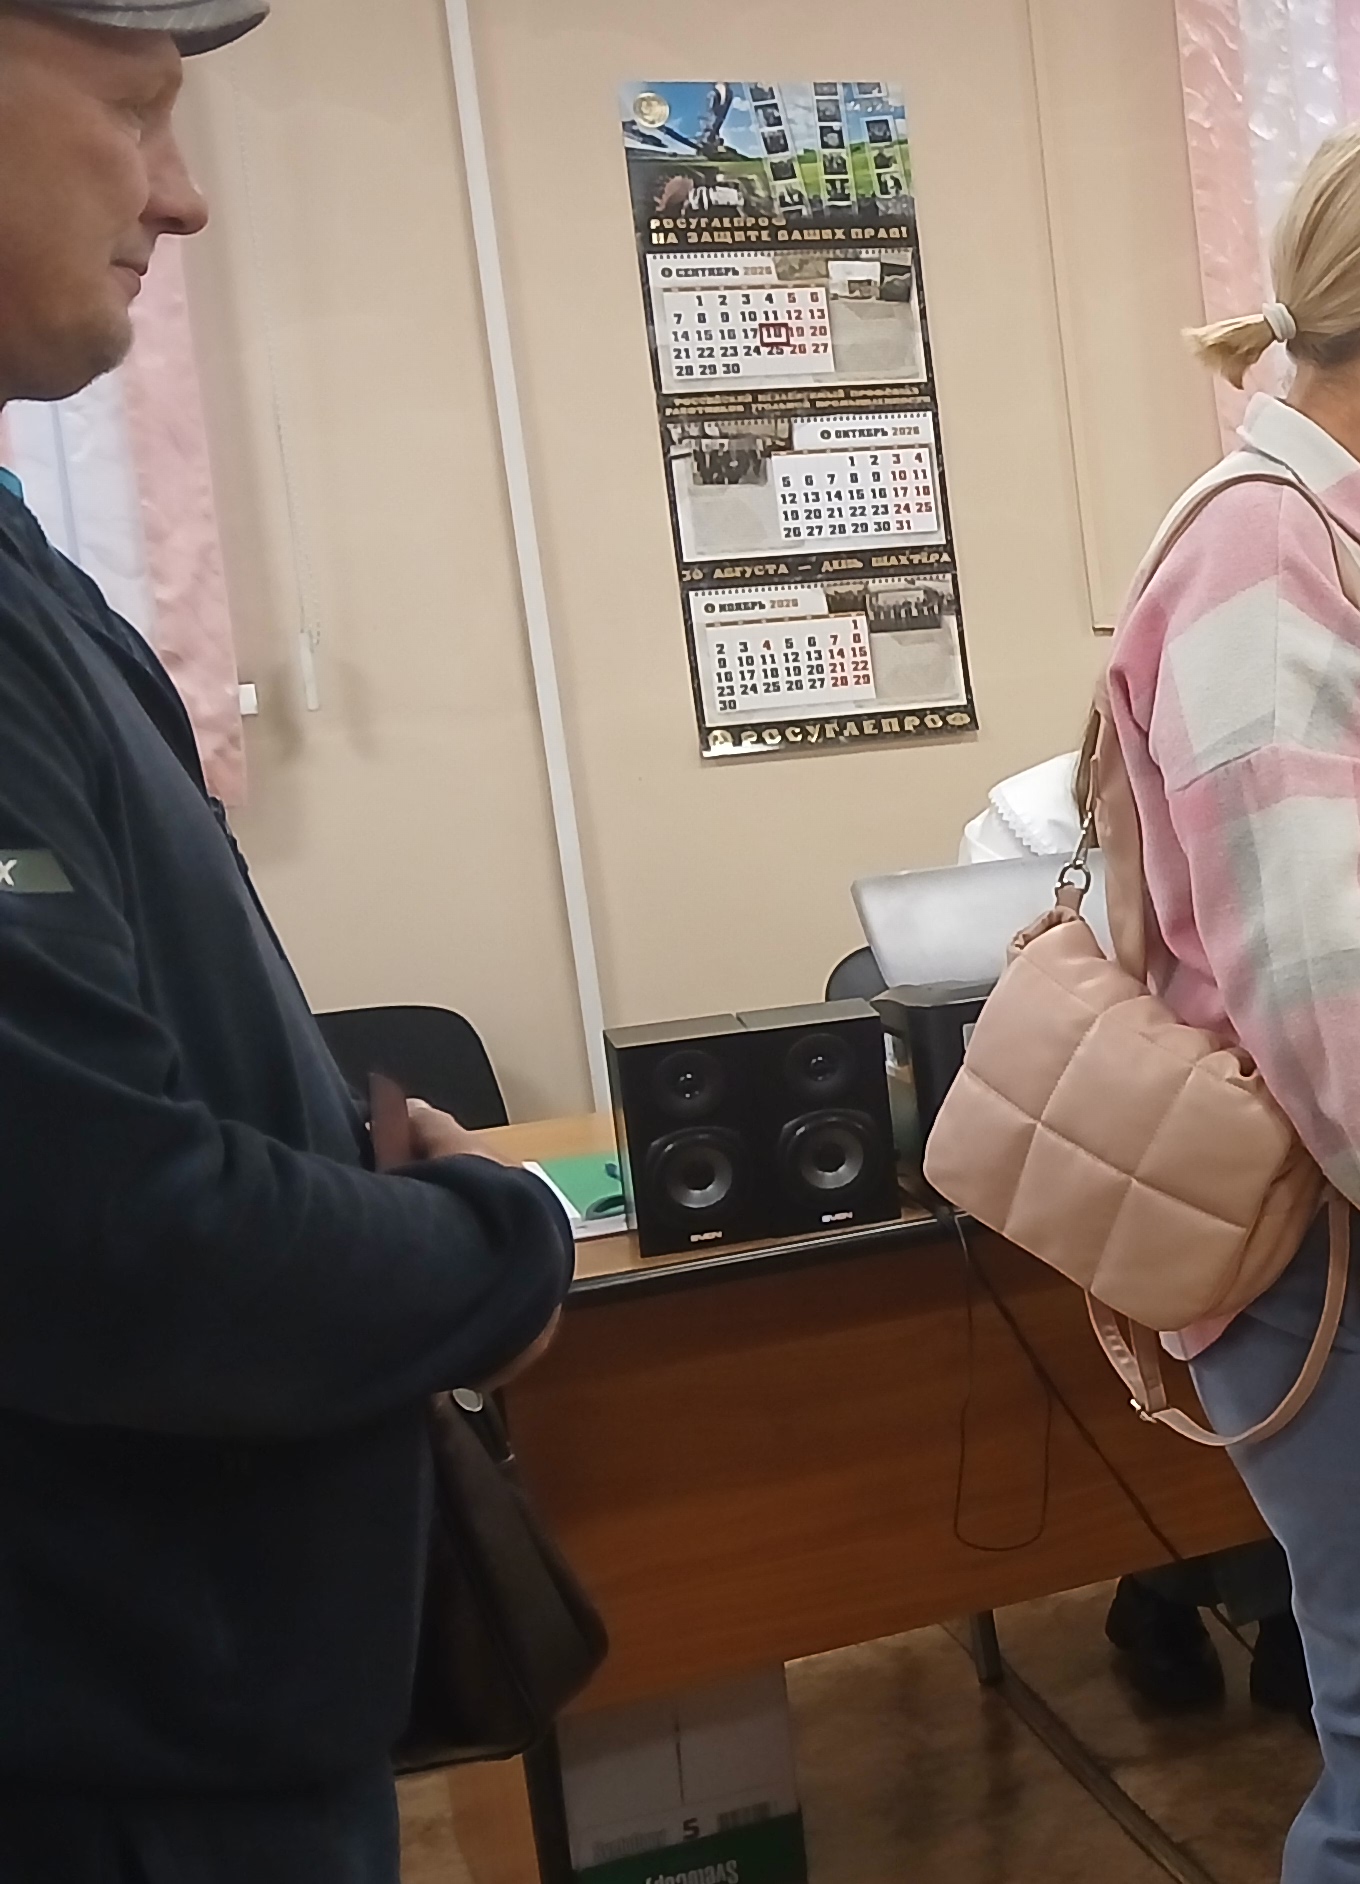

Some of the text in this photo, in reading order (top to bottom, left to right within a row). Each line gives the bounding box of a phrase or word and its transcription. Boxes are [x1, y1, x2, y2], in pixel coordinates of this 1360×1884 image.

[652, 226, 908, 245] НА ЗАЩИТЕ ВАШИХ ПРАВ!
[675, 267, 739, 278] СЕНТЯБРЬ
[696, 295, 703, 306] 1
[718, 295, 728, 306] 2
[742, 294, 750, 305] 3
[765, 293, 774, 304] 4
[787, 292, 796, 303] 5
[674, 313, 682, 324] 7
[740, 311, 757, 322] 10
[763, 310, 778, 321] 11
[786, 309, 802, 320] 12
[809, 308, 825, 320] 13
[672, 331, 690, 342] 14
[696, 330, 713, 341] 15
[742, 328, 758, 339] 17
[810, 326, 827, 336] 20
[673, 348, 690, 359] 21
[696, 347, 715, 358] 22
[720, 346, 738, 357] 23
[743, 346, 761, 356] 24
[766, 345, 785, 356] 25
[812, 343, 828, 354] 27
[722, 363, 740, 374] 30
[834, 428, 888, 439] ОКТЯБРЬ
[849, 452, 922, 466] 1 2 3 4
[782, 476, 791, 487] 5
[827, 474, 835, 484] 7
[891, 470, 907, 481] 10
[913, 469, 927, 480] 11
[781, 493, 797, 504] 12
[803, 492, 820, 503] 13
[826, 490, 842, 502] 14
[848, 489, 864, 500] 15
[893, 486, 908, 498] 17
[804, 508, 822, 520] 20
[827, 507, 843, 518] 21
[849, 506, 867, 517] 22
[871, 504, 889, 516] 23
[894, 503, 911, 514] 24
[915, 502, 932, 513] 25
[806, 525, 823, 536] 27
[874, 521, 890, 532] 30
[896, 520, 911, 530] 31
[713, 563, 789, 580] АВГУСТА
[821, 558, 864, 573] ДЕНЬ
[719, 600, 766, 613] НОЯБРЬ
[852, 619, 858, 630] 1
[716, 644, 725, 654] 2
[739, 642, 748, 653] 3
[763, 640, 771, 650] 4
[785, 638, 794, 649] 5
[830, 634, 838, 645] 7
[738, 656, 754, 667] 10
[760, 654, 776, 665] 11
[783, 652, 800, 663] 12
[806, 650, 822, 661] 13
[828, 648, 845, 660] 14
[851, 646, 867, 658] 15
[739, 669, 755, 681] 17
[806, 664, 824, 675] 20
[829, 662, 845, 673] 21
[851, 660, 869, 671] 22
[717, 685, 735, 697] 23
[740, 683, 758, 695] 24
[763, 681, 780, 693] 25
[808, 678, 825, 689] 27
[719, 699, 736, 711] 30
[740, 711, 971, 747] РОСУГЛЕПРОФ
